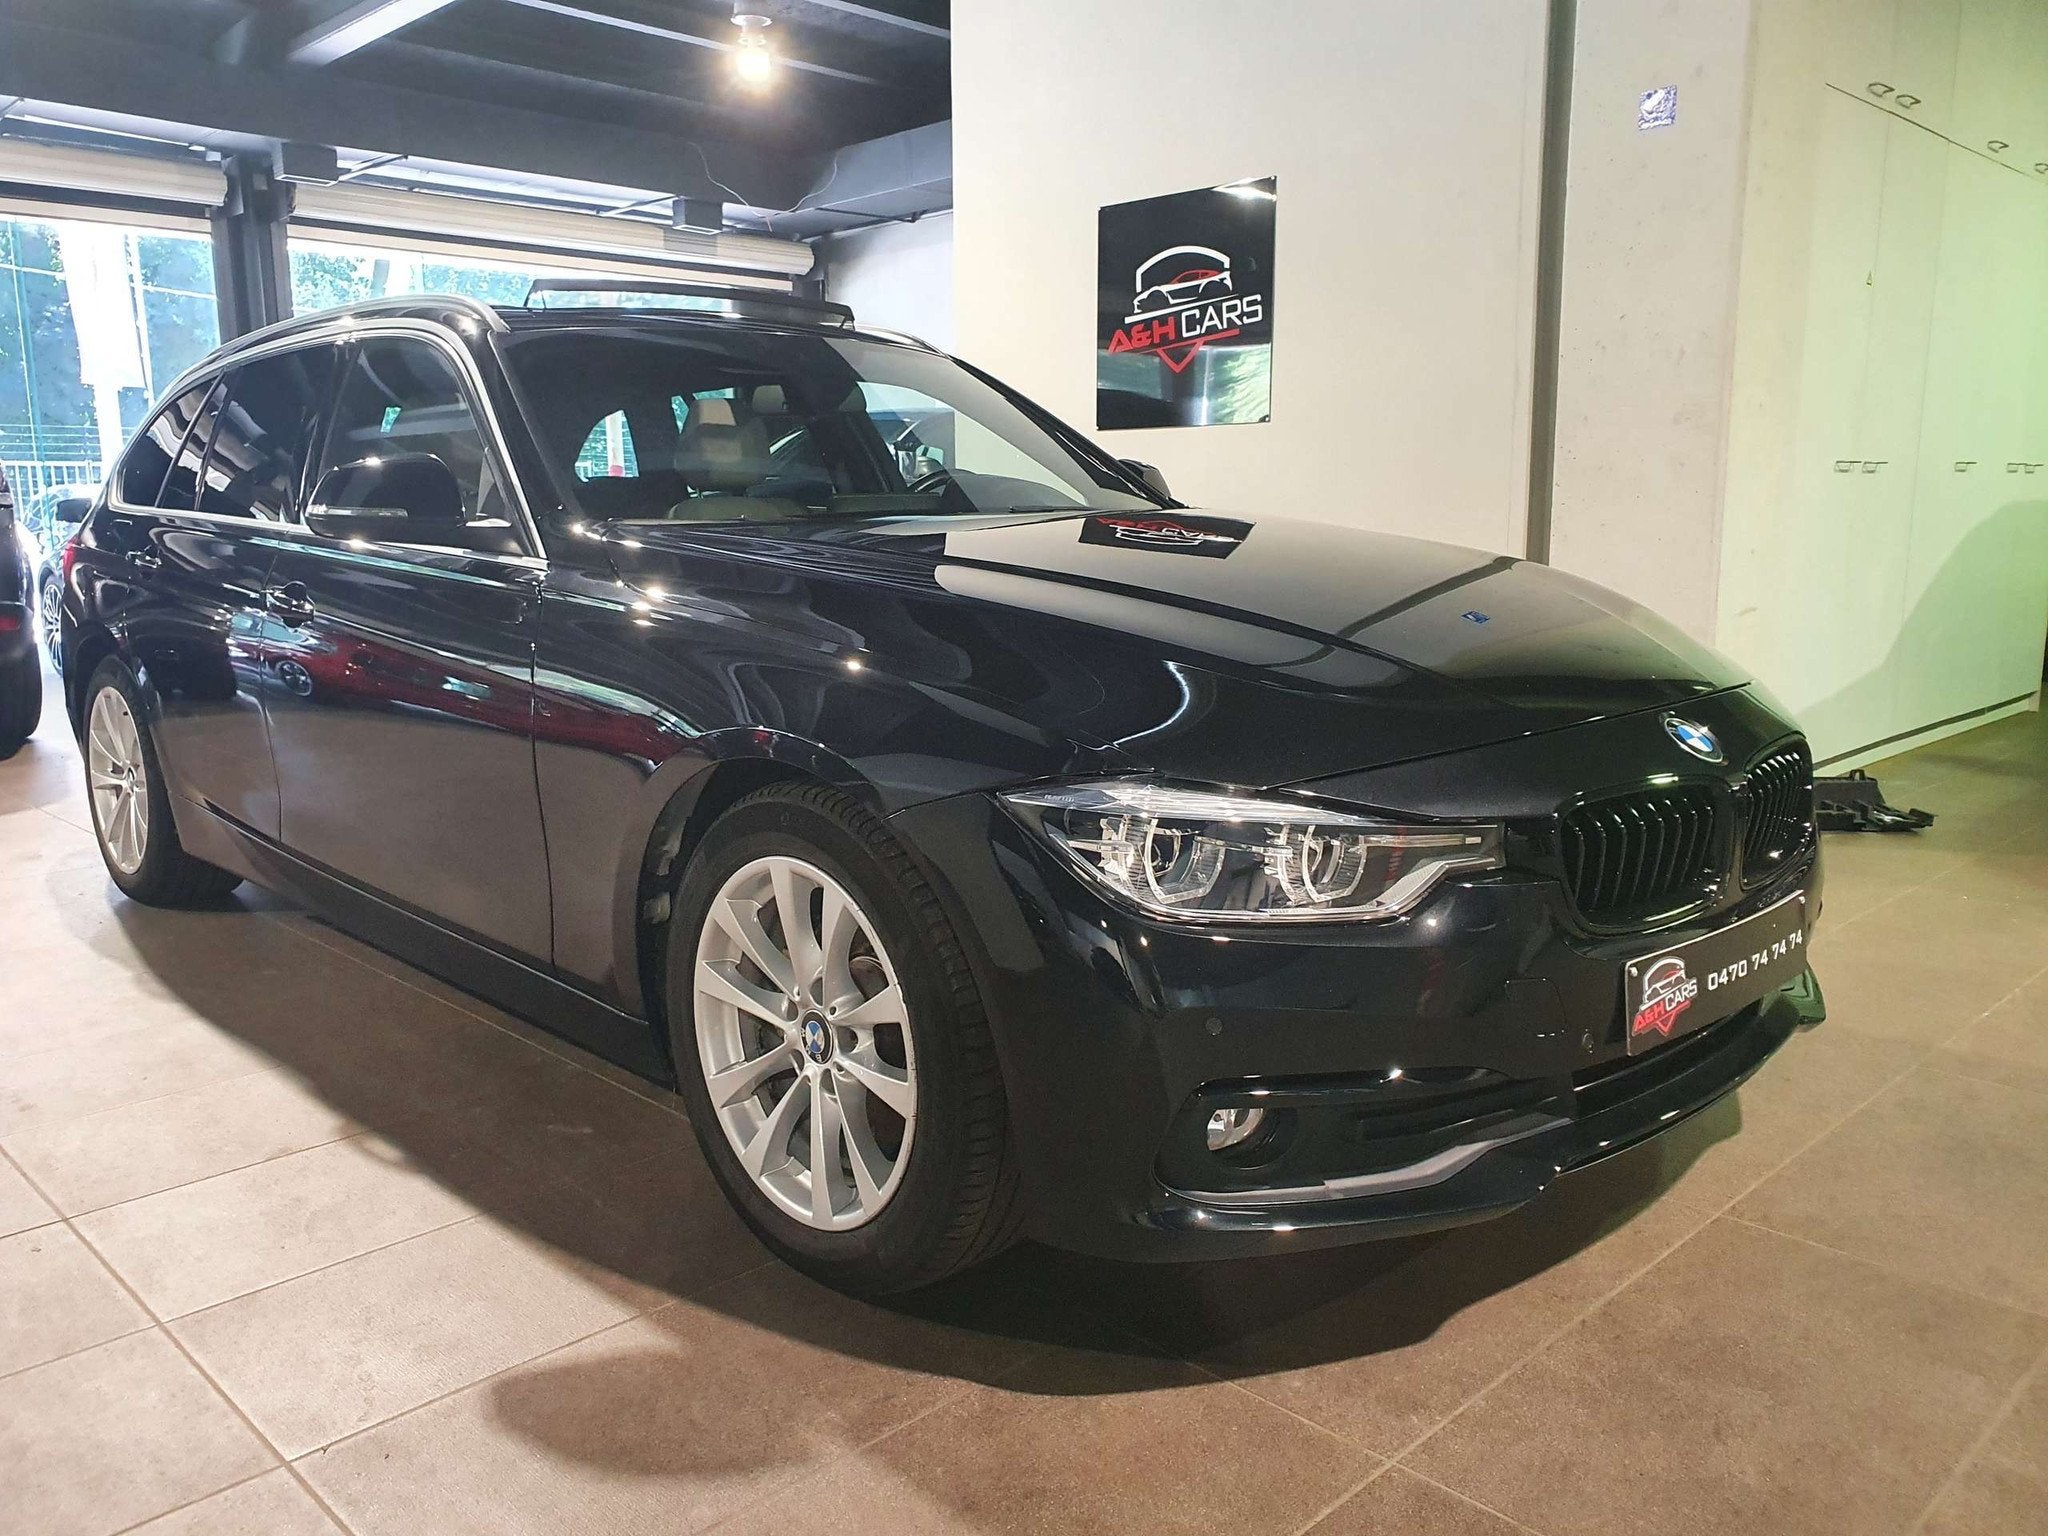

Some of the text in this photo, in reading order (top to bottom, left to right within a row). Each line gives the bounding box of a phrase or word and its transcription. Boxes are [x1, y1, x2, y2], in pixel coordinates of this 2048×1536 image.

[1108, 294, 1263, 354] A&H CARS
[1707, 929, 1803, 991] 0470 74 74 74
[1665, 978, 1698, 1011] CARS
